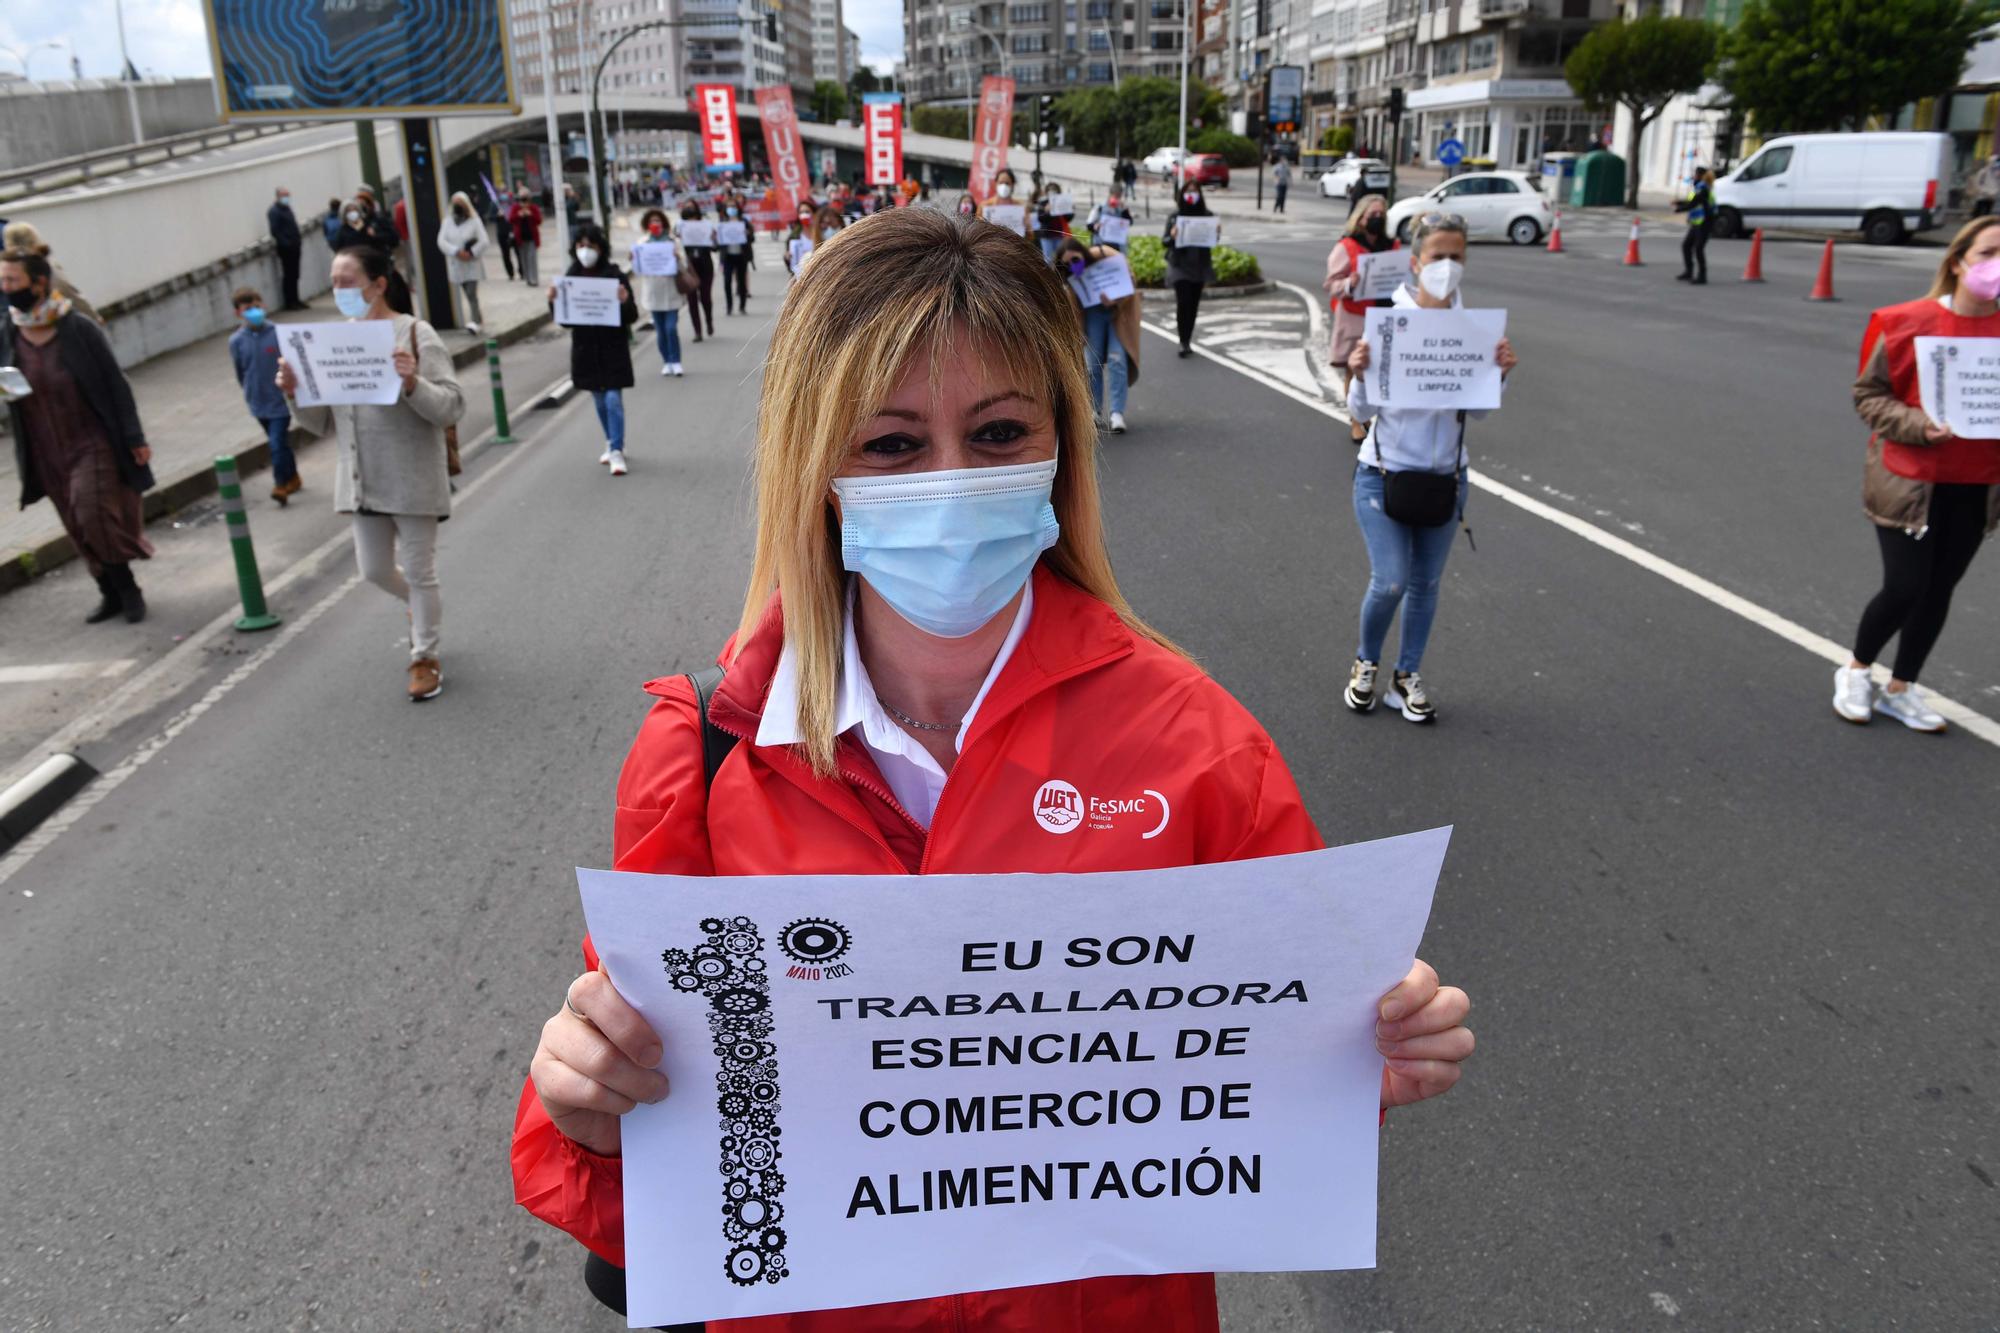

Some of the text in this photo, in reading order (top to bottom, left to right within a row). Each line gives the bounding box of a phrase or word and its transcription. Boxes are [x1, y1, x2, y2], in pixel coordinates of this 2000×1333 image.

[771, 127, 801, 209] UGT
[980, 118, 1004, 199] UGT
[1422, 338, 1463, 348] EU SON
[1400, 352, 1484, 363] TRABALLADORA
[1406, 367, 1475, 378] ESENCIAL DE
[1417, 382, 1463, 393] LIMPEZA
[1040, 788, 1077, 811] UGT
[1090, 797, 1145, 813] FeSMC
[1090, 813, 1112, 821] Galicia
[962, 935, 1195, 973] EU SON
[785, 962, 854, 981] MAIO 2021
[818, 981, 1309, 1020] TRABALLADORA
[872, 1027, 1250, 1070] ESENCIAL DE
[859, 1083, 1252, 1139] COMERCIO DE
[846, 1146, 1261, 1219] ALIMENTACIÓN
